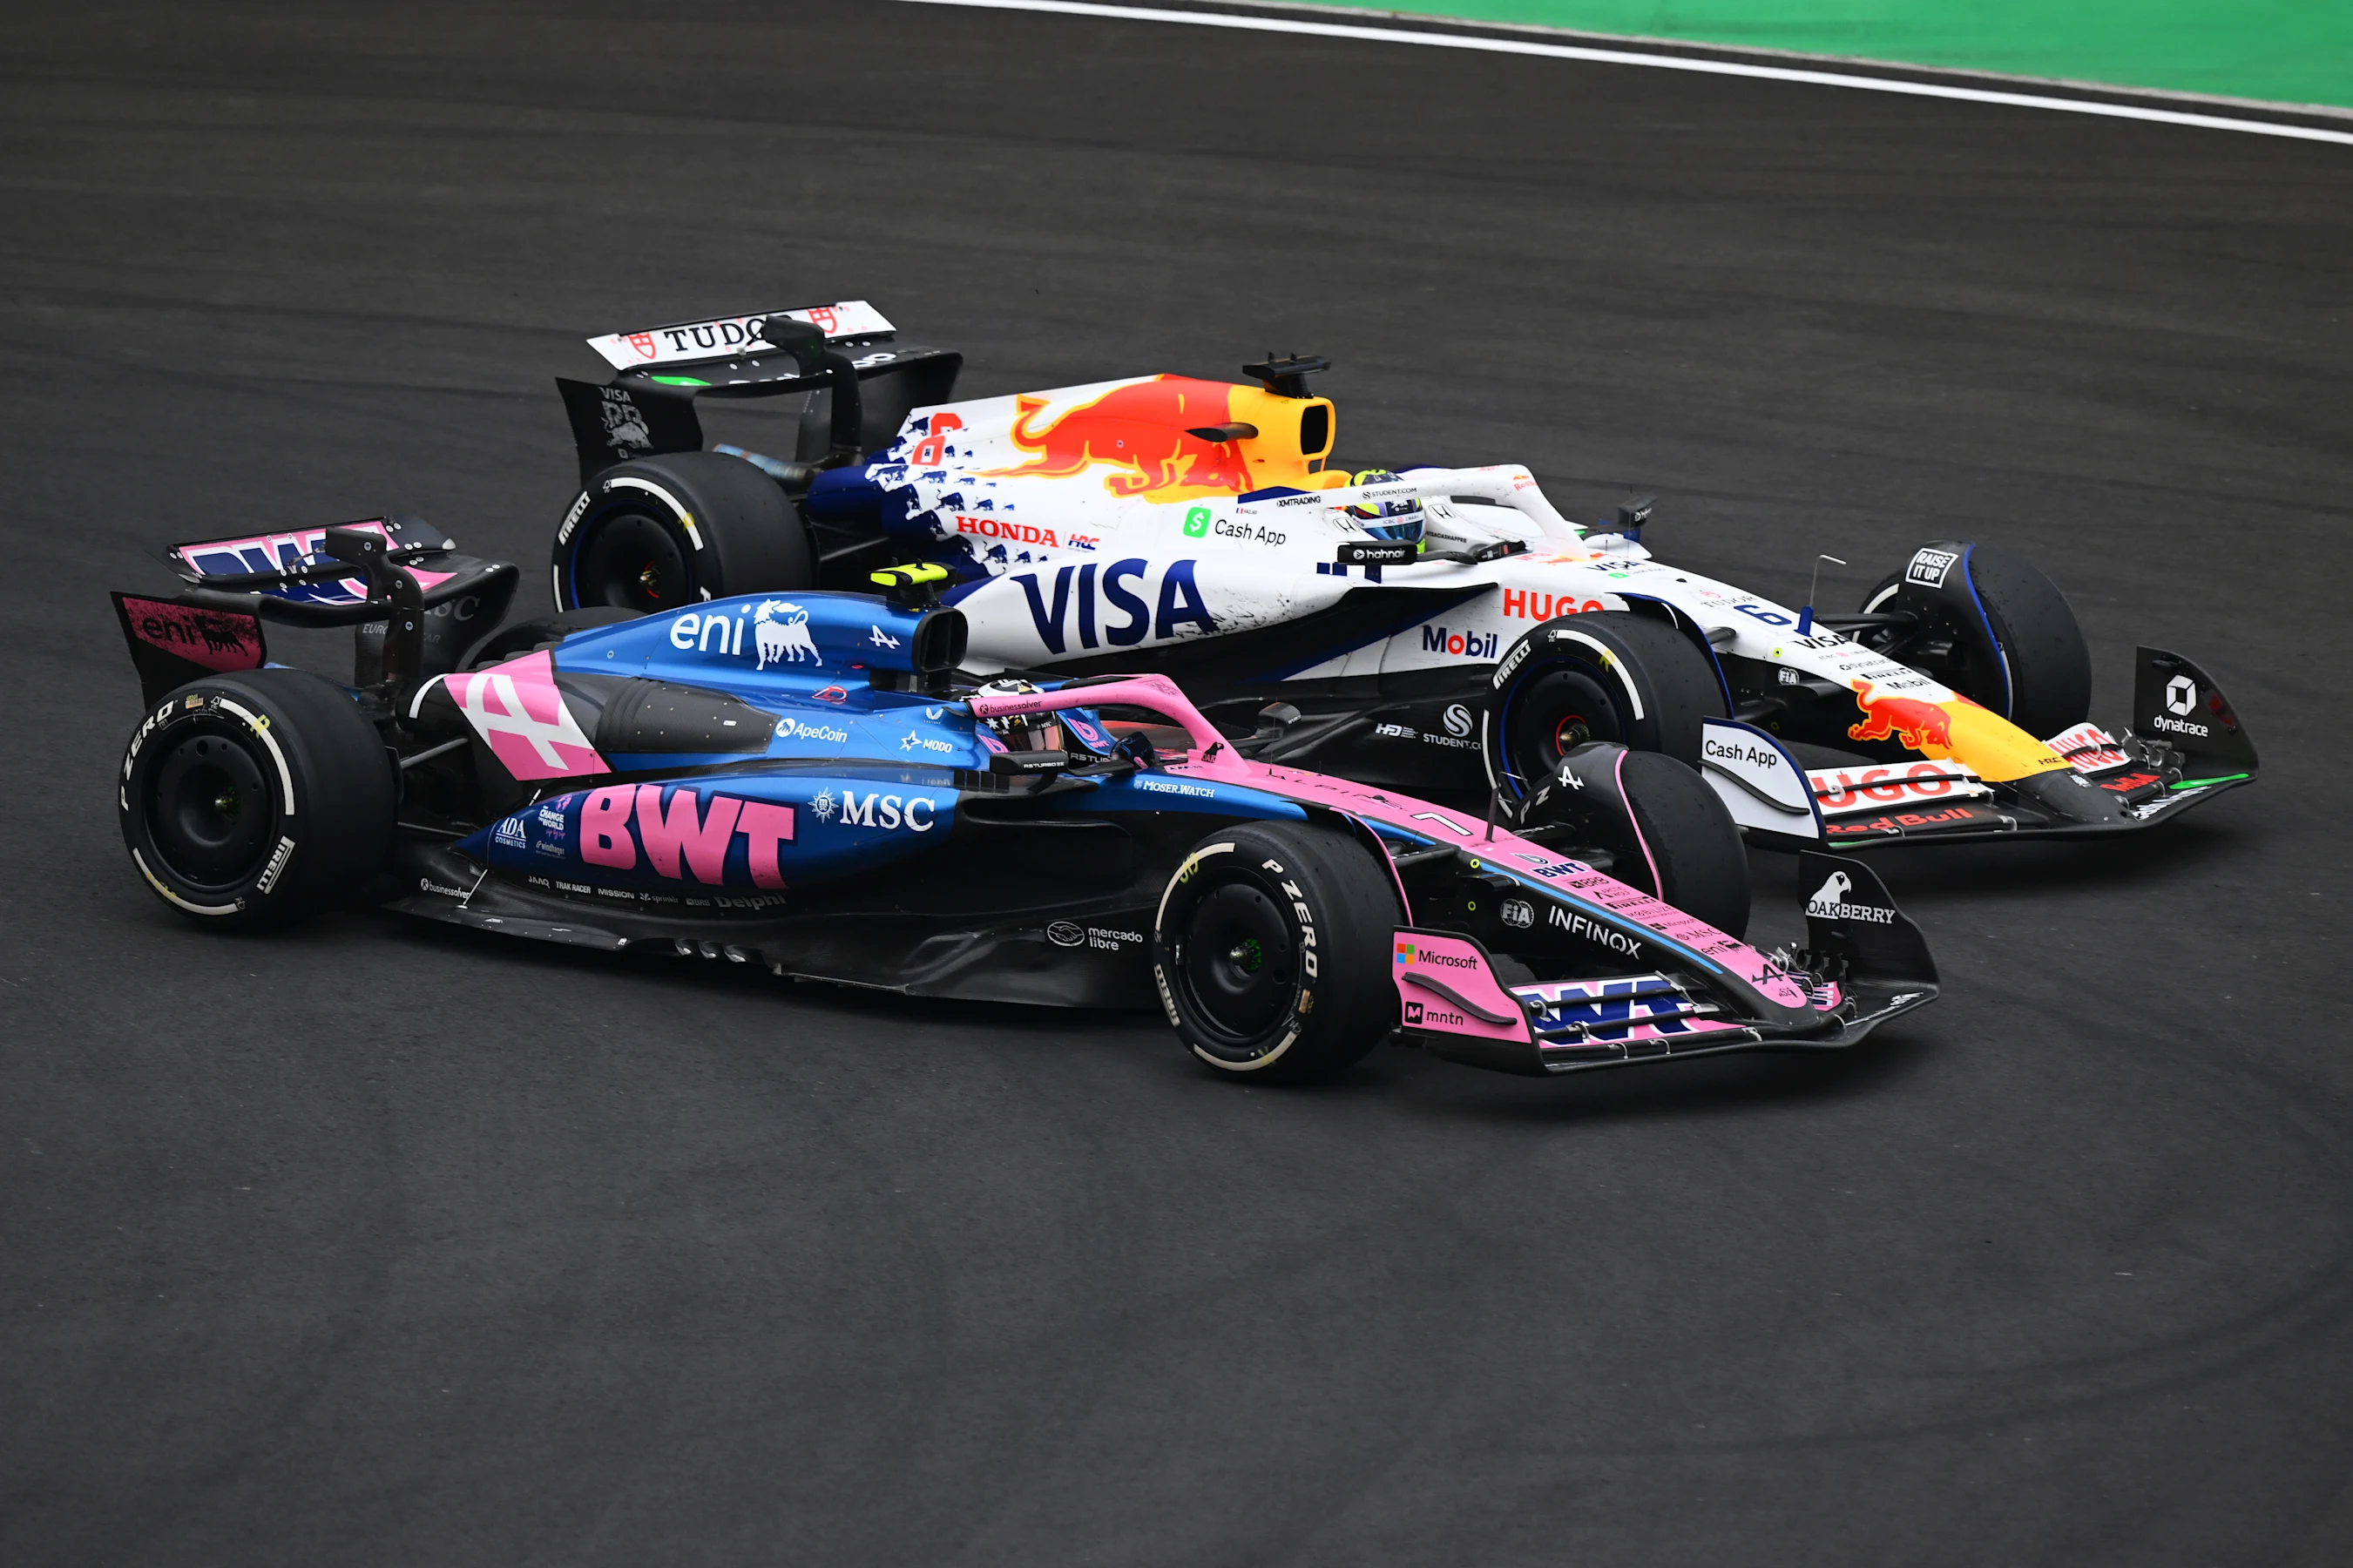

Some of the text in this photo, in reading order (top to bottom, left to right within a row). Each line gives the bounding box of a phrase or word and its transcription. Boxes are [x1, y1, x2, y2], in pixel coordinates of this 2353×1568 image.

[663, 314, 791, 352] TUDO
[598, 387, 632, 403] VISA
[1372, 487, 1417, 497] STUDENT.COM
[558, 490, 591, 545] PIRELLI
[956, 516, 1059, 548] HONDA
[1215, 519, 1286, 547] Cash App
[1367, 548, 1405, 559] hahnair
[1917, 552, 1951, 568] RAISE
[1913, 564, 1940, 581] IT UP
[424, 596, 481, 621] SC
[1010, 558, 1220, 655] VISA
[1701, 595, 1761, 609] TUDOR
[1734, 605, 1792, 625] 6
[143, 616, 195, 645] eni
[670, 604, 752, 656] eni
[1422, 625, 1498, 659] Mobil
[1791, 634, 1851, 650] VISA
[1493, 639, 1531, 690] PIRELLI
[990, 700, 1042, 713] businessolver
[794, 722, 848, 743] ApeCoin
[1376, 723, 1403, 737] HPD
[2154, 714, 2208, 737] dynatrace
[923, 739, 953, 753] MODO
[1705, 740, 1777, 768] Cash App
[120, 700, 173, 811] P ZERO
[1143, 781, 1215, 798] MOSER.WATCH
[539, 808, 565, 823] CHANGE
[839, 790, 935, 832] MSC
[497, 817, 526, 839] ADA
[543, 820, 564, 830] WORLD
[1826, 808, 1973, 834] Red Bull
[495, 836, 526, 848] COSMETICS
[579, 783, 795, 889] BWT
[541, 841, 565, 855] windhager
[256, 835, 296, 895] PIRELLI
[1532, 862, 1587, 878] BWT
[429, 881, 471, 899] businessolver
[556, 881, 592, 894] TRAK RACER
[1580, 877, 1610, 888] BRB
[598, 888, 635, 899] MISSION
[652, 894, 679, 904] sprinklr
[714, 893, 787, 910] Delphi
[1605, 896, 1656, 909] PIRELLI
[1261, 858, 1318, 978] P ZERO
[1807, 900, 1897, 924] OAKBERRY
[1664, 917, 1698, 928] Microsoft
[1088, 927, 1143, 943] mercado
[1548, 905, 1641, 960] INFINOX
[1687, 927, 1722, 940] MSC
[1089, 936, 1119, 950] libre
[1701, 943, 1728, 956] eni
[1418, 950, 1477, 970] Microsoft
[1154, 963, 1180, 1026] PIRELLI
[1426, 1010, 1464, 1026] mntn
